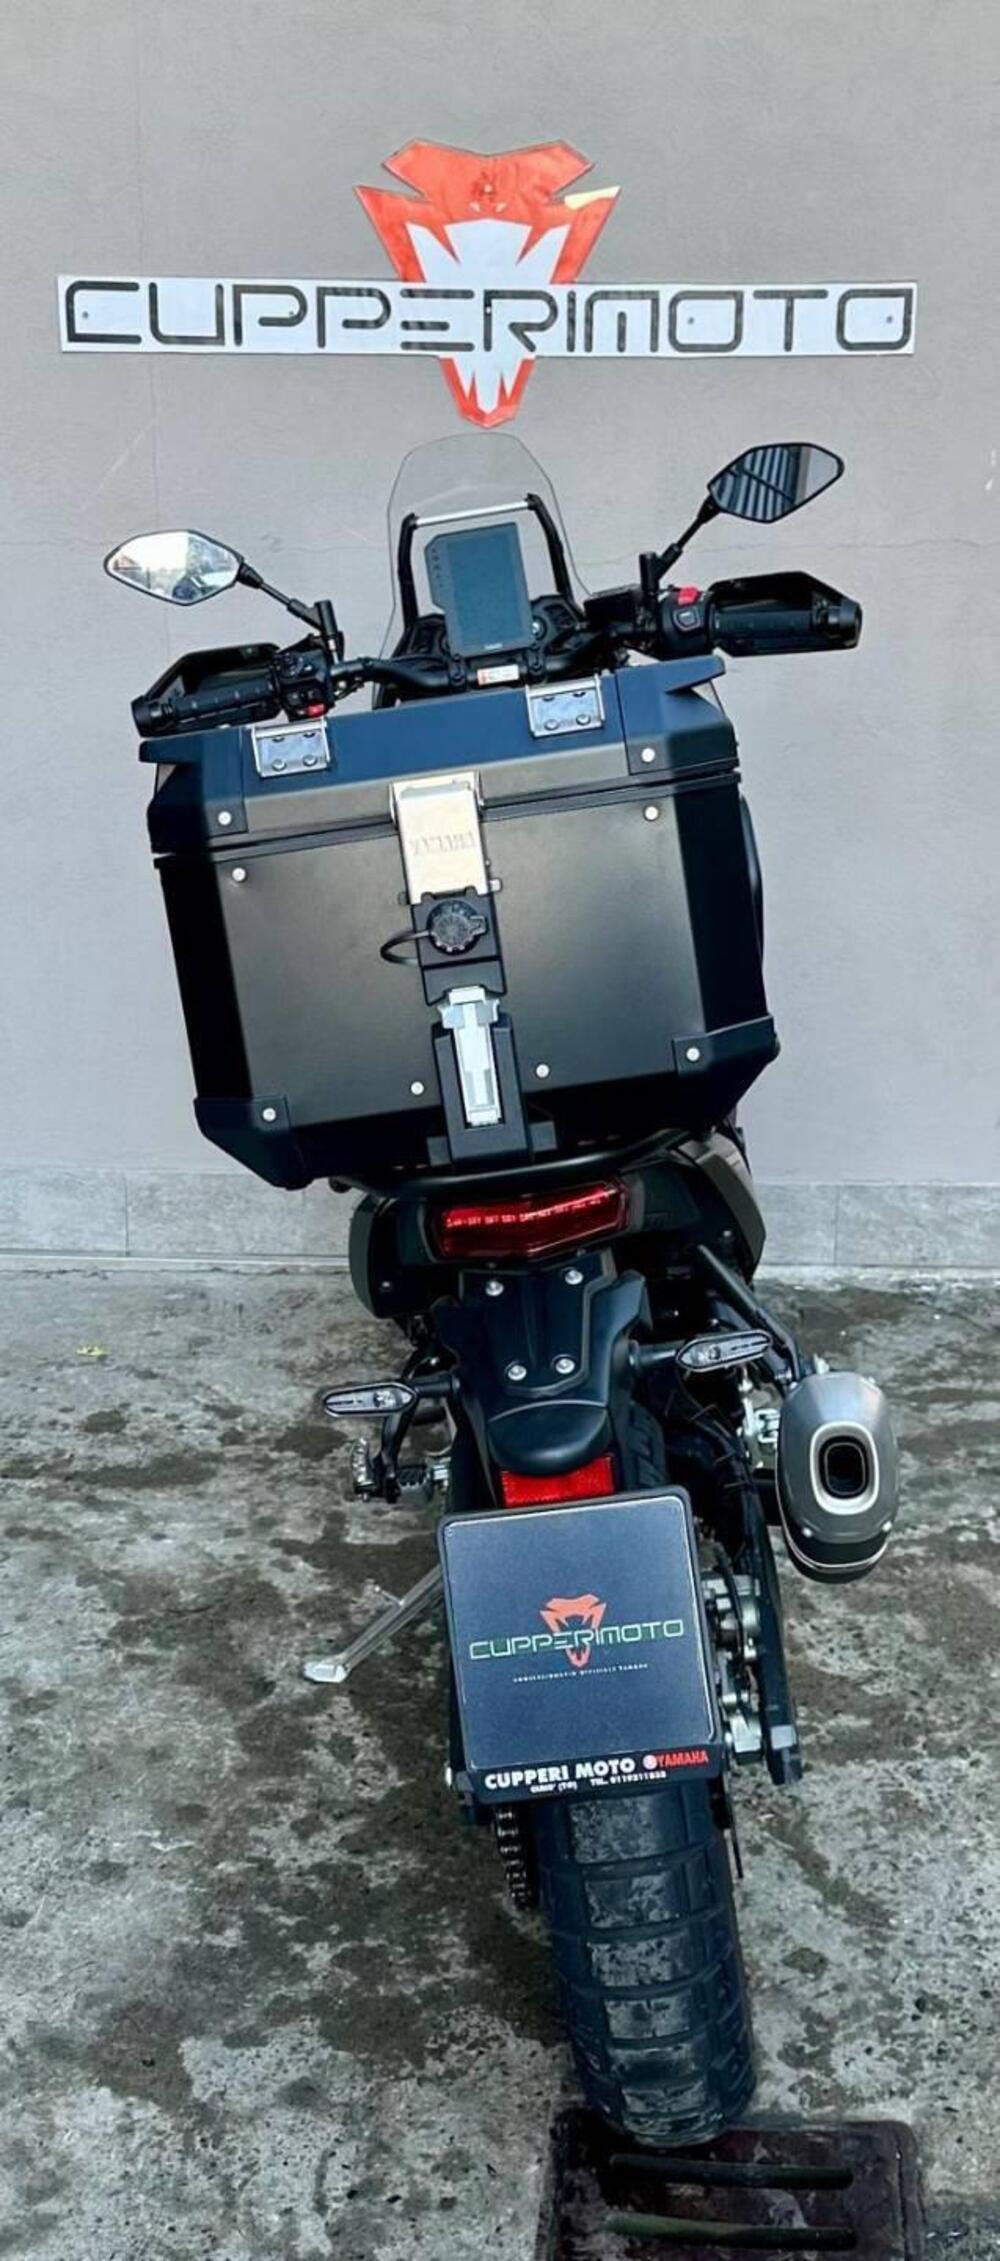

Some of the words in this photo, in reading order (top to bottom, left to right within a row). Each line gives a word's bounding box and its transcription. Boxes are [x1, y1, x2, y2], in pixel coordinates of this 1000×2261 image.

[65, 280, 914, 353] CUPPERIMOTO
[469, 1619, 685, 1660] CUPPERIMOTO
[484, 1765, 570, 1789] CUPPERI
[575, 1757, 636, 1779] MOTO
[657, 1750, 710, 1768] YAMAHA
